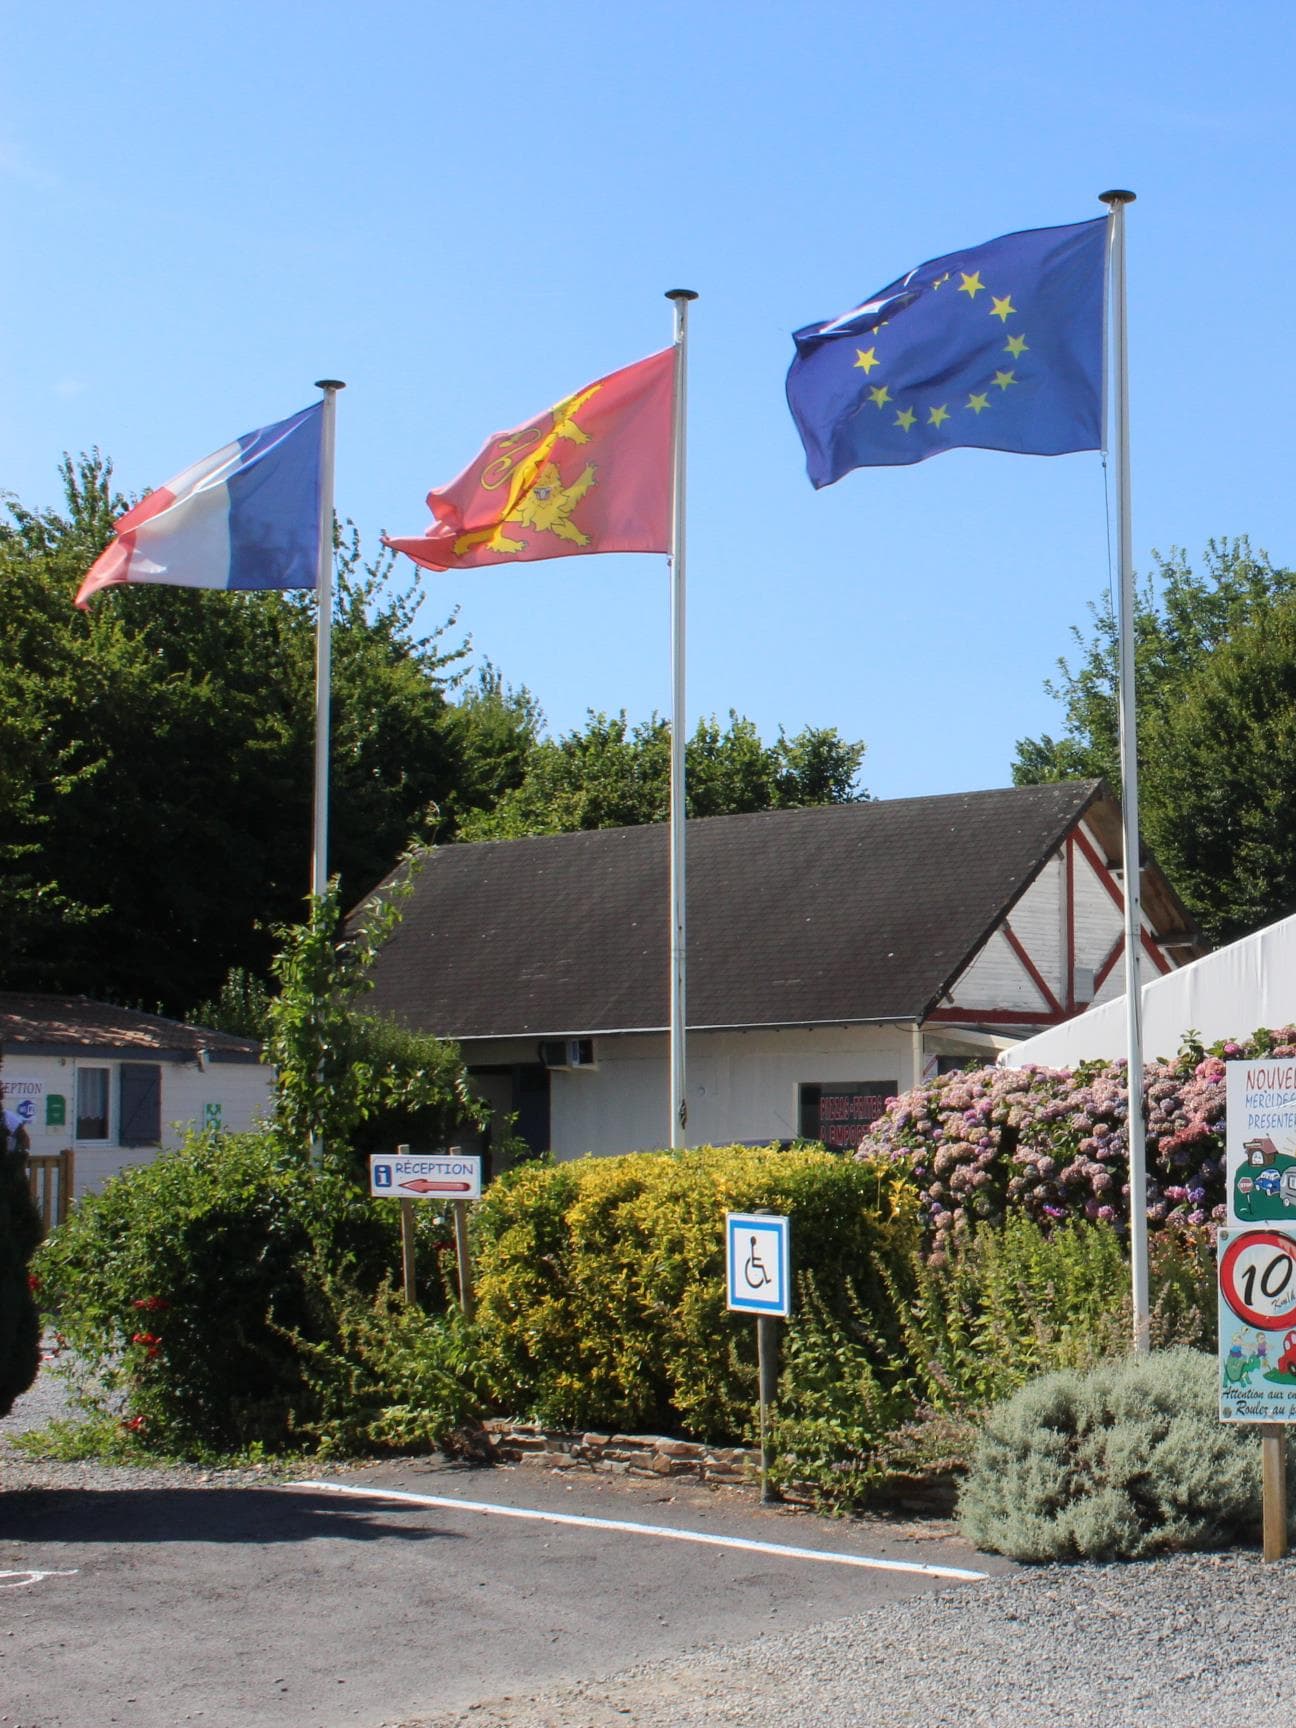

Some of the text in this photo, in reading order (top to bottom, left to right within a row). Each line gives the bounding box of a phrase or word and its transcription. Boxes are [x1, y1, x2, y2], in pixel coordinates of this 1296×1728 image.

[1, 1082, 42, 1095] EPTION
[1246, 1093, 1274, 1109] MERCI
[395, 1159, 473, 1175] RÉCEPTION
[1242, 1253, 1293, 1306] 10
[1222, 1386, 1264, 1400] Attention
[1267, 1391, 1283, 1399] aux
[1235, 1400, 1268, 1419] Roulez
[1272, 1405, 1285, 1415] au
